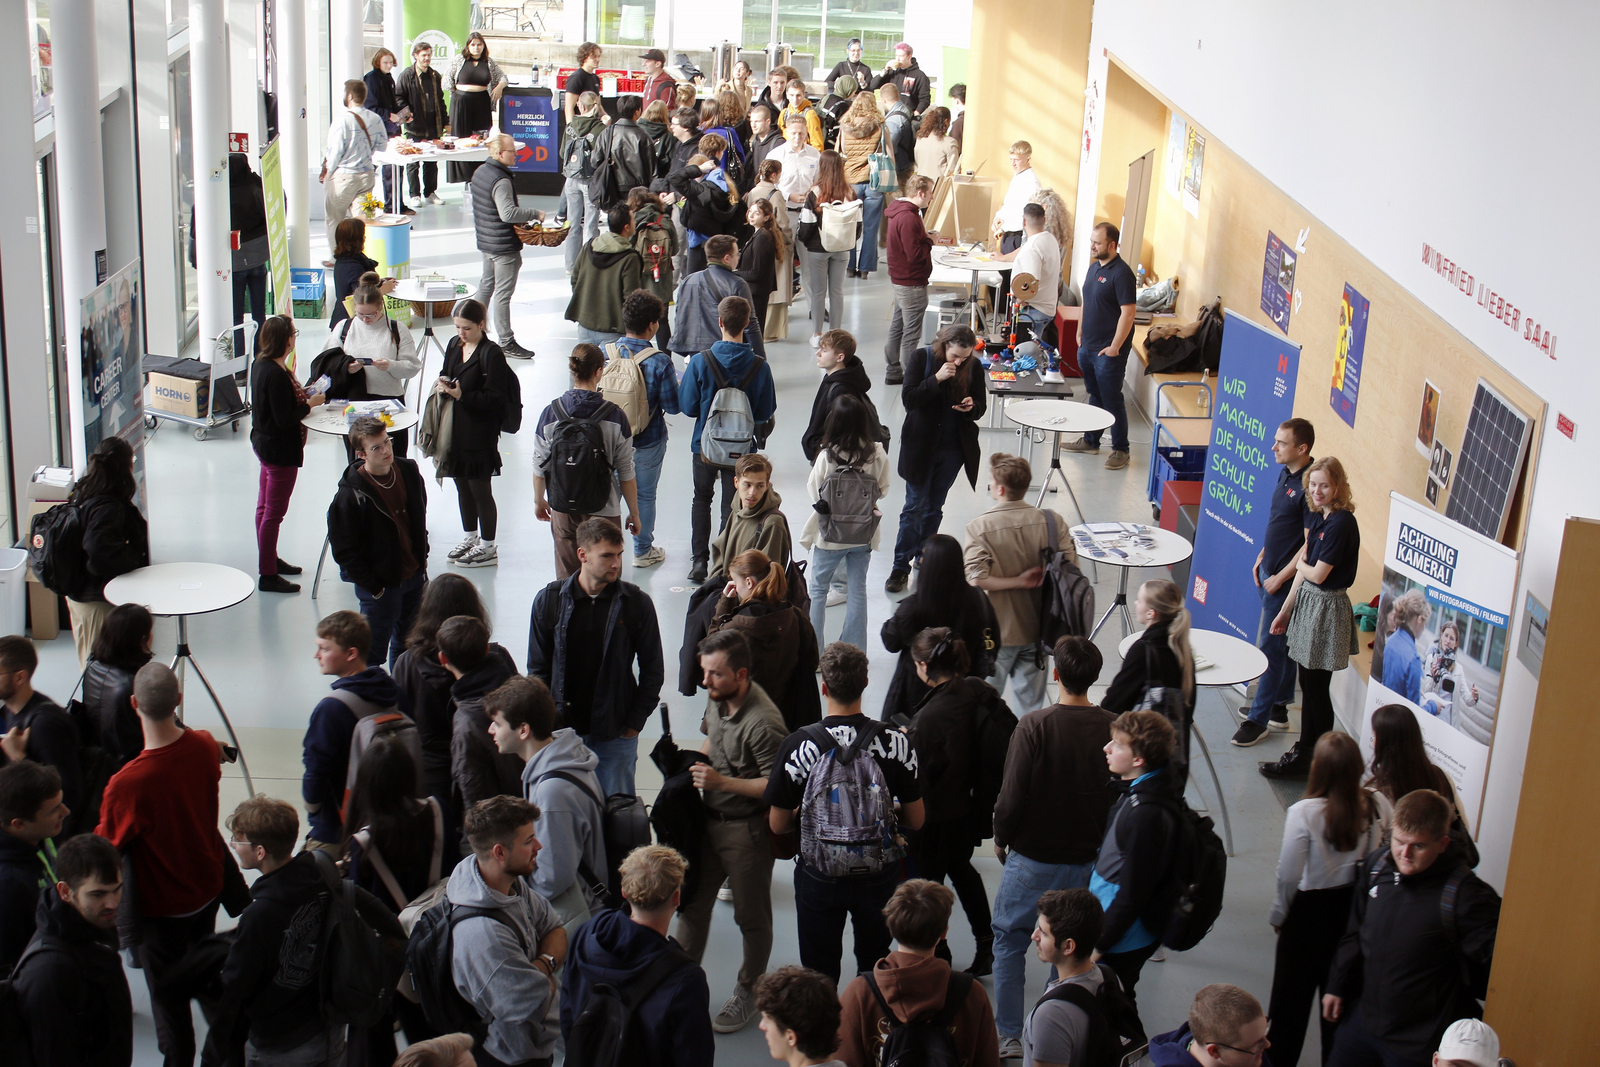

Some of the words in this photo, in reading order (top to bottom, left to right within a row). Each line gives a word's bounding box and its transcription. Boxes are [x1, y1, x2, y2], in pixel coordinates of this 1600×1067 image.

[535, 146, 549, 162] D
[1421, 241, 1475, 297] WINFRIED
[1477, 283, 1522, 333] LIEBER
[1523, 317, 1558, 361] SAAL
[93, 356, 123, 395] CAREER
[1277, 353, 1289, 375] H
[100, 381, 121, 409] CENTER
[155, 385, 183, 400] HORN
[1223, 375, 1247, 400] WIR
[1219, 402, 1266, 442] MACHEN
[1215, 427, 1234, 451] DIE
[1235, 438, 1269, 471] HOCH-
[1211, 453, 1256, 493] SCHULE
[1397, 543, 1450, 584] KAMERA!
[1399, 525, 1455, 566] ACHTUNG
[1428, 588, 1440, 600] WIR
[1439, 593, 1480, 616] FOTOGRAFIEREN
[1482, 610, 1505, 625] FILMEN
